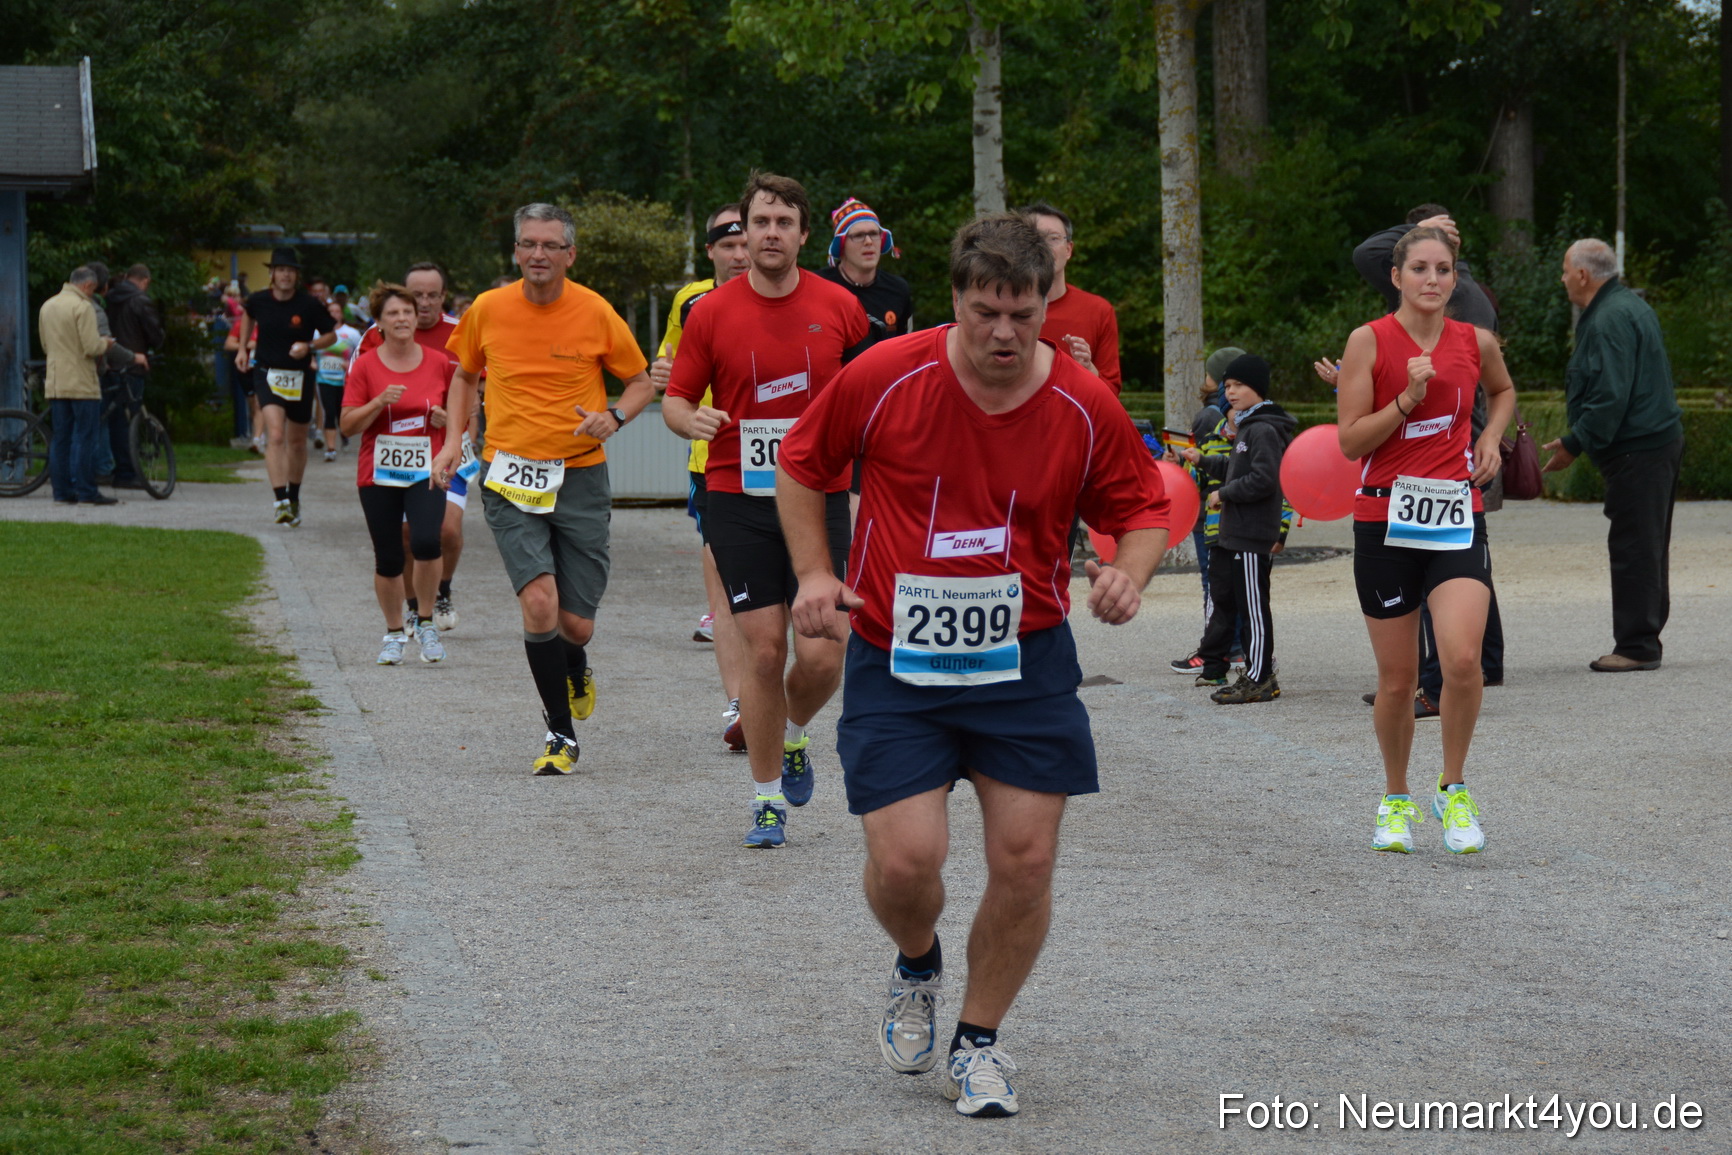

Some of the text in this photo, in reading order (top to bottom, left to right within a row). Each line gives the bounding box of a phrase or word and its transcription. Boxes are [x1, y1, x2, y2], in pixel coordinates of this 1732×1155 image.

[274, 375, 295, 388] 231
[770, 380, 794, 394] DEHN
[742, 426, 791, 435] PARTL Neu
[1418, 422, 1440, 433] DEHN
[380, 448, 426, 468] 2625
[750, 438, 781, 467] 30
[389, 471, 416, 480] Monika
[503, 462, 549, 490] 265
[499, 486, 542, 505] Reinhard
[1394, 481, 1460, 496] PARTL Neumarkt
[1397, 494, 1465, 526] 3076
[952, 536, 986, 550] DEHN
[898, 584, 1002, 600] PARTL Neumarkt
[907, 604, 1011, 647] 2399
[930, 656, 986, 670] Günter
